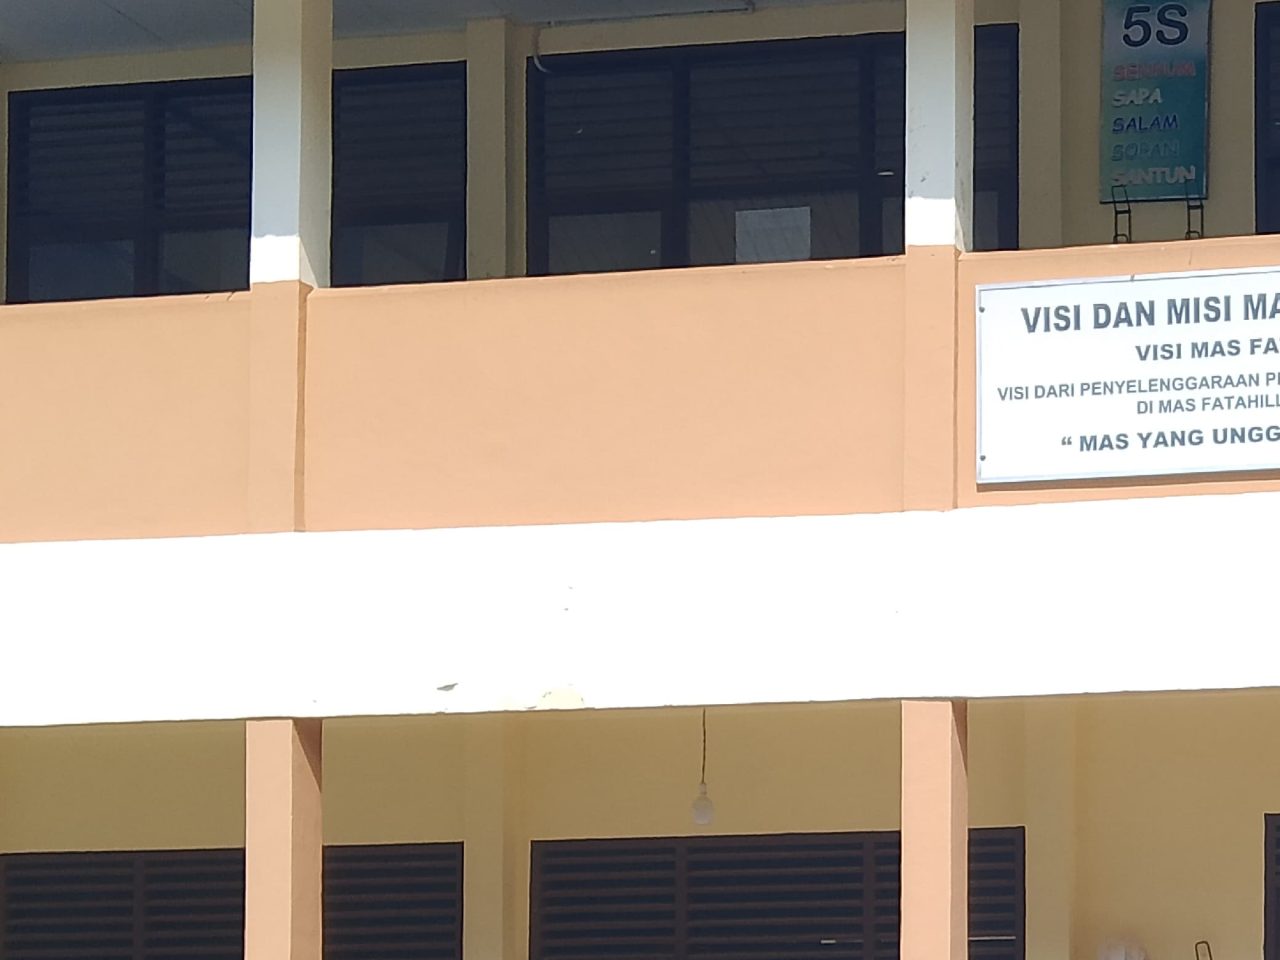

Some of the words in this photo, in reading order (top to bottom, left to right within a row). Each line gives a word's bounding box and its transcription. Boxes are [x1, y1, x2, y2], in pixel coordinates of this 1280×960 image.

[1122, 3, 1189, 48] 5S
[1112, 87, 1163, 107] SAPA
[1111, 114, 1179, 133] SALAM
[1111, 165, 1197, 185] SANTUN
[1021, 304, 1080, 333] VISI
[1093, 300, 1155, 329] DAN
[1167, 295, 1231, 325] MISI
[1135, 343, 1181, 361] VISI
[1191, 340, 1240, 358] MAS
[997, 386, 1029, 401] VISI
[1035, 383, 1074, 399] DARI
[1080, 373, 1259, 396] PENYELENGGARAAN
[1137, 401, 1153, 414] DI
[1159, 398, 1196, 413] MAS
[1080, 433, 1129, 452] MAS
[1137, 429, 1203, 448] YANG
